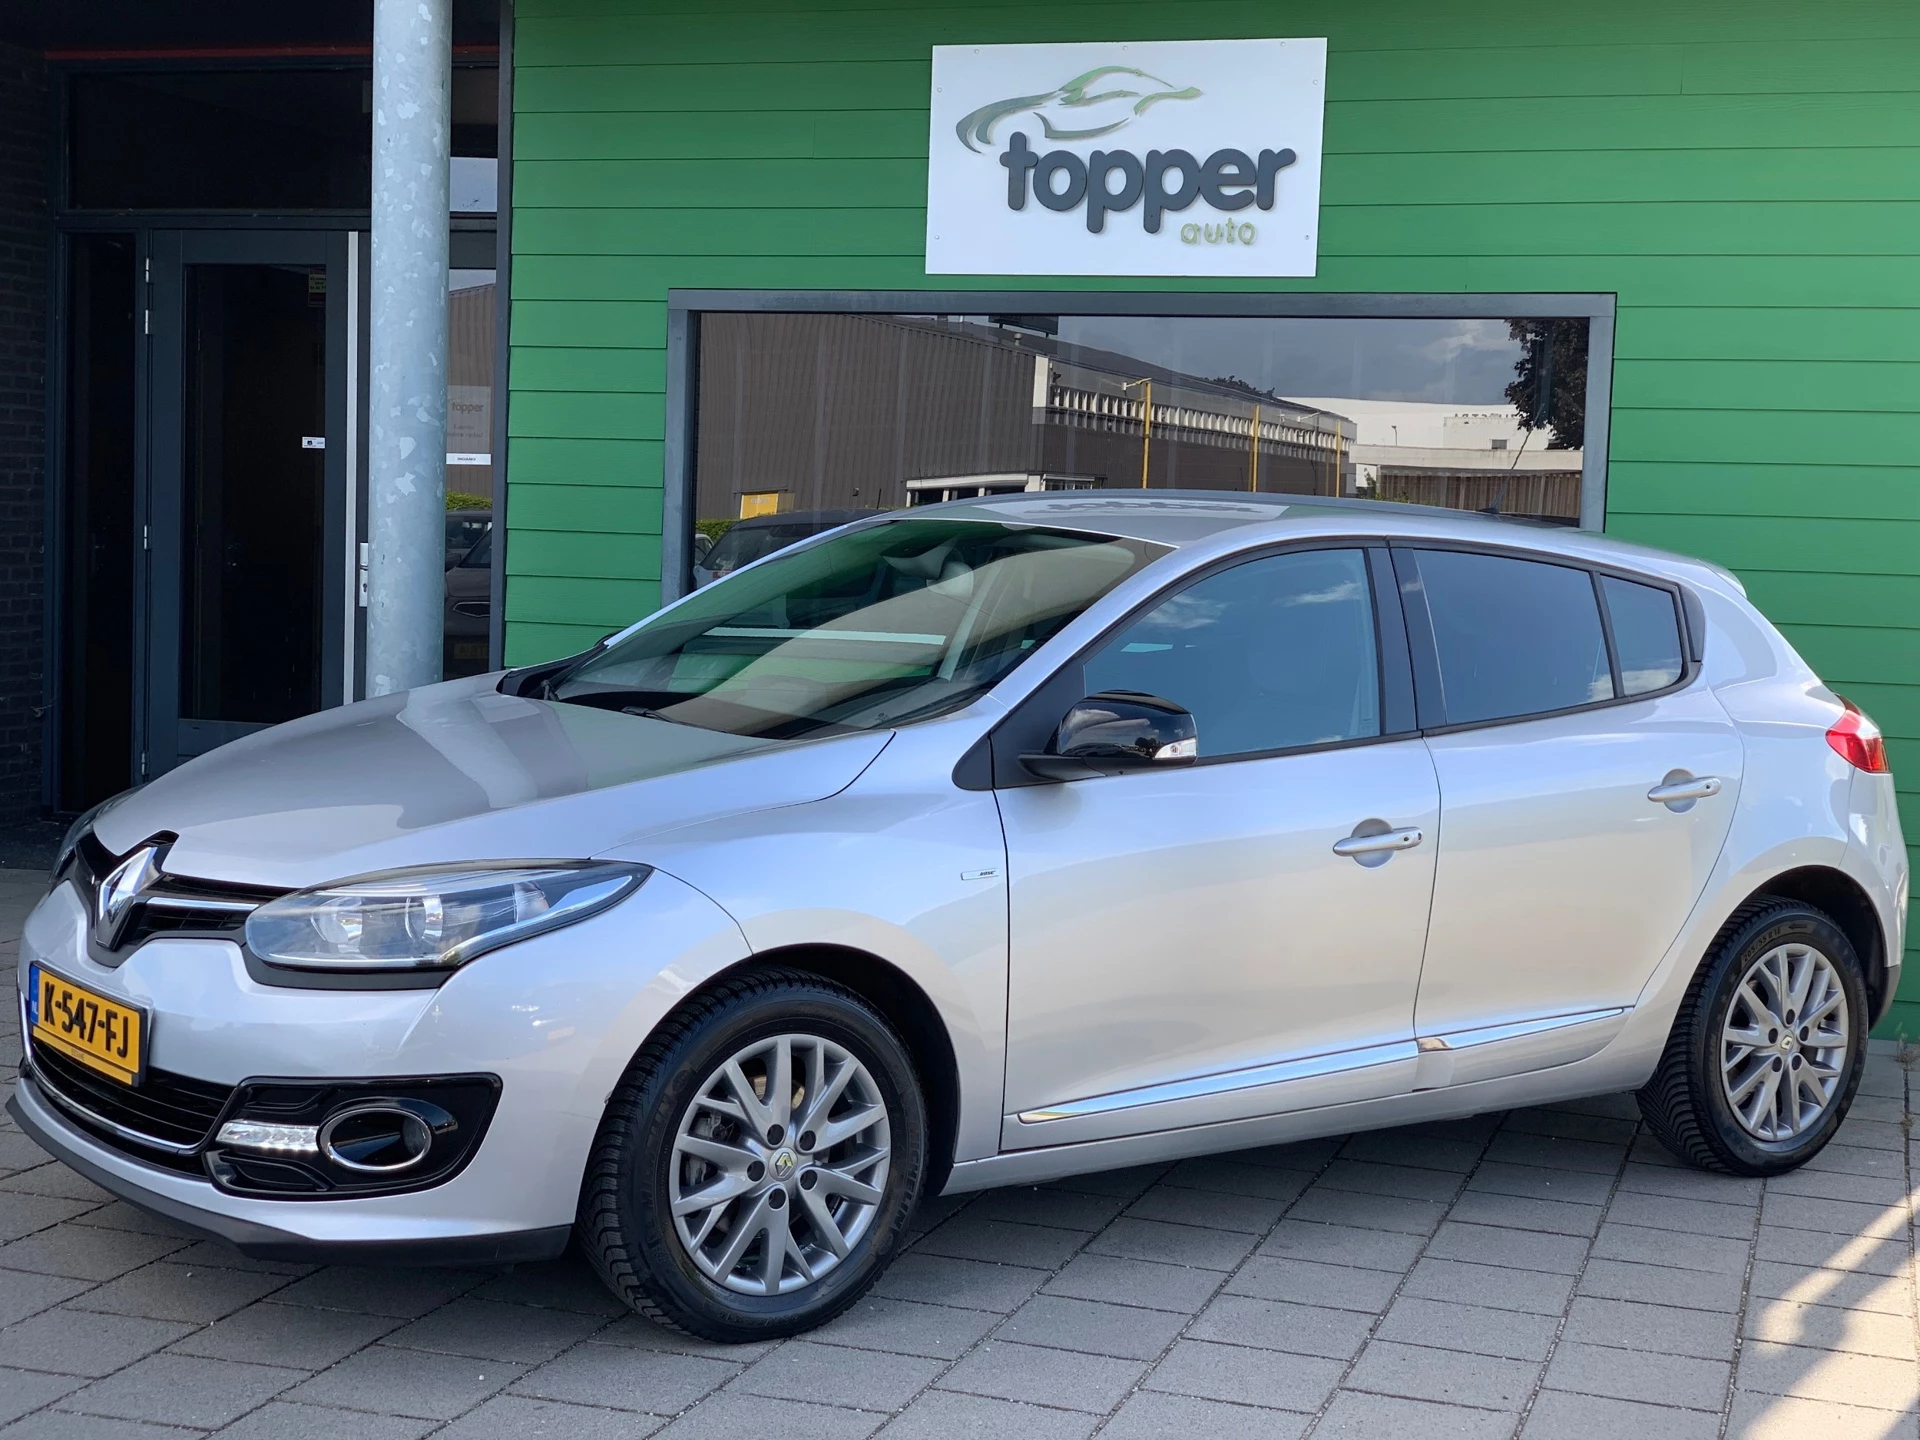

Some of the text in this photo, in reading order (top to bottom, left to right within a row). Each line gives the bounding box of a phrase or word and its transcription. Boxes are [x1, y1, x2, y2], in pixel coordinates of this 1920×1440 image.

[1000, 131, 1297, 234] topper
[1180, 218, 1256, 245] auto
[451, 402, 484, 414] topper
[44, 980, 129, 1059] K-547-FJ
